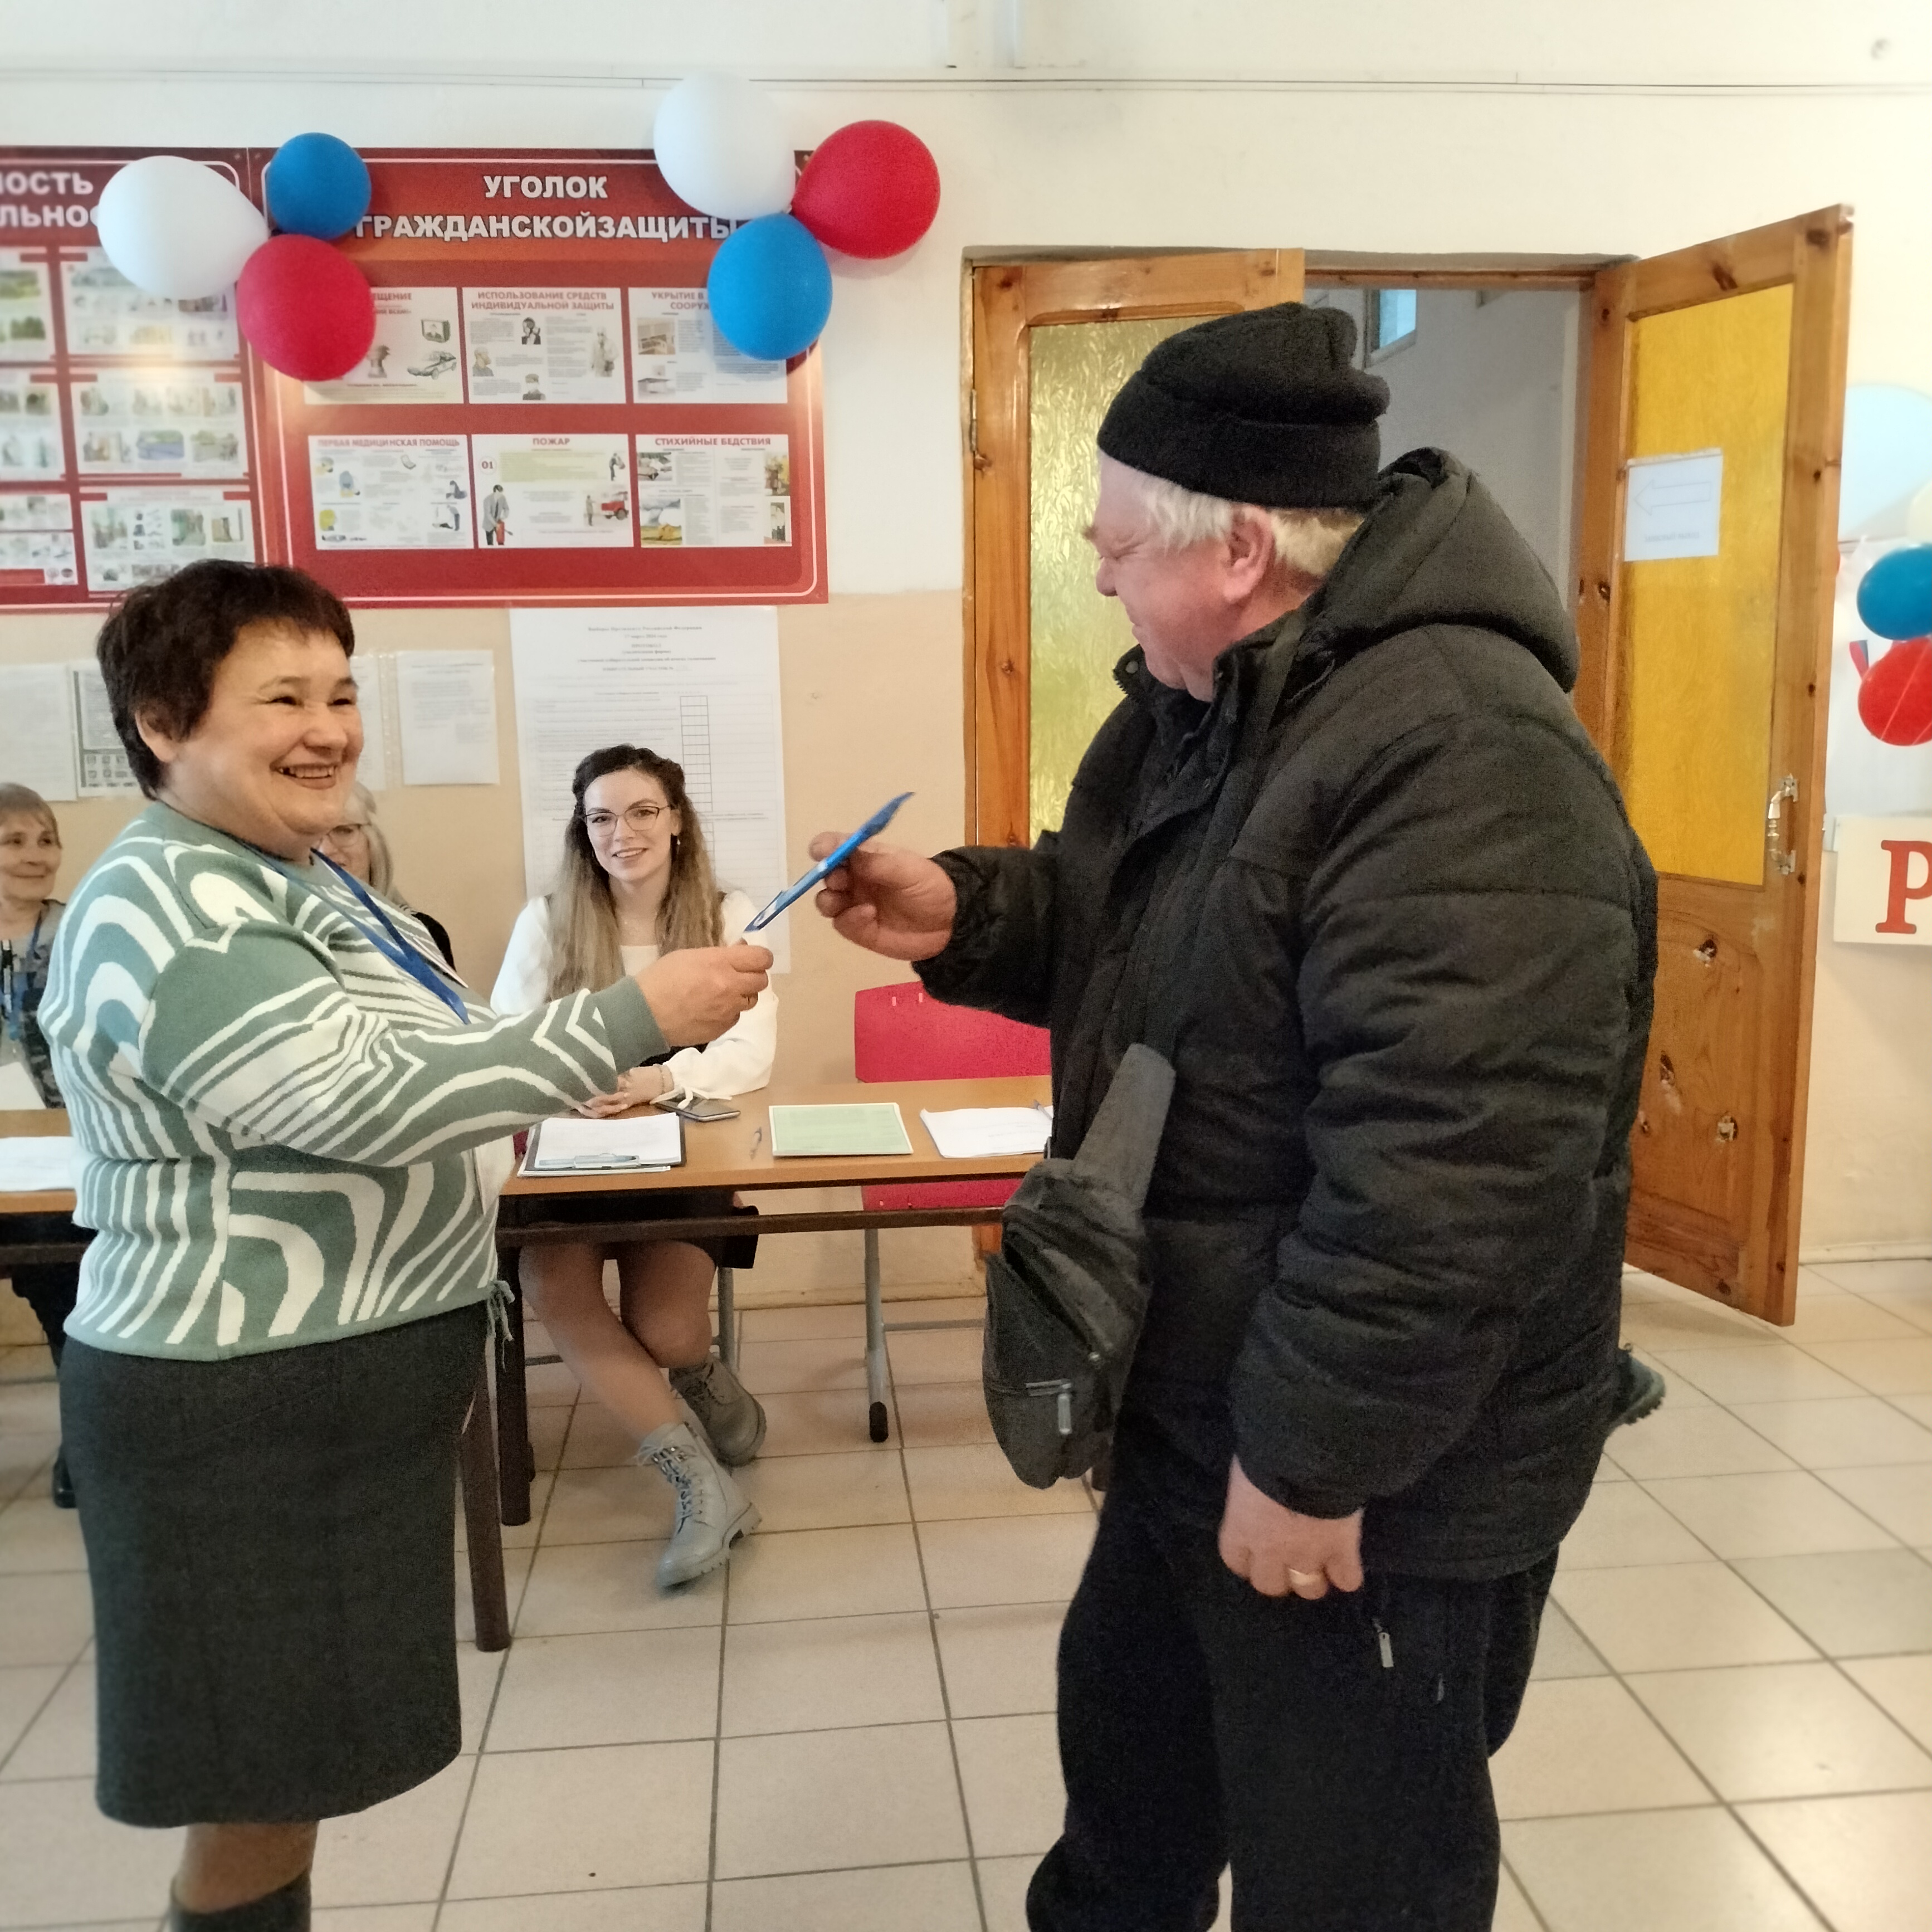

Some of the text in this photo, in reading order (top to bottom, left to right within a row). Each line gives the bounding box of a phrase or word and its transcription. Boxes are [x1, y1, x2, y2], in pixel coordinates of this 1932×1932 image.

[483, 175, 608, 198] УГОЛОК
[0, 204, 98, 228] ЛЬНО
[567, 292, 607, 300] СРЕДСТВ
[471, 301, 614, 310] ИНДИВИДУАЛЬНОЙ ЗАЩИТЫ
[419, 439, 460, 447] ПОМОЩЬ
[533, 437, 570, 446] ПОЖАР
[655, 437, 771, 446] СТИХИЙНЫЕ БЕДСТВИЯ
[481, 461, 494, 469] 01
